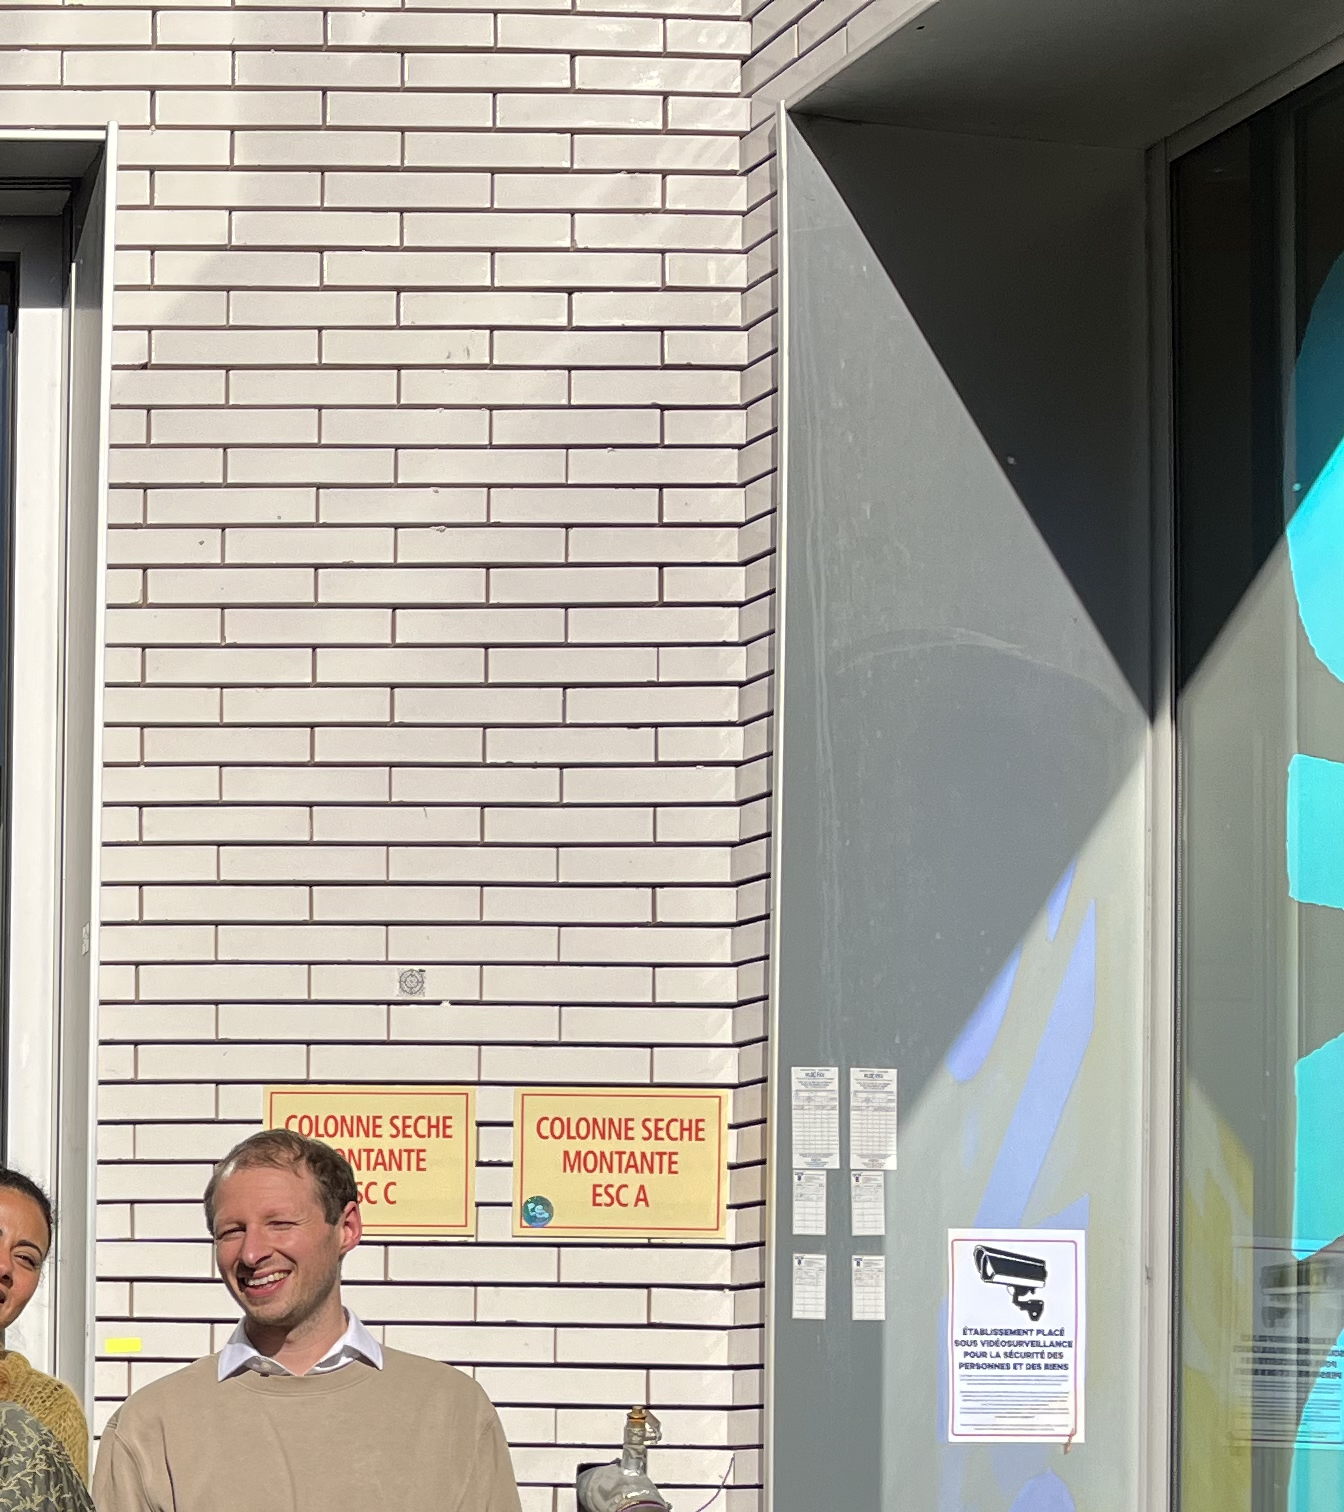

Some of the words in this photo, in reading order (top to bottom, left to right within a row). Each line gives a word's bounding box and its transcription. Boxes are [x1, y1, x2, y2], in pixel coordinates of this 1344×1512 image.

[284, 1114, 383, 1138] COLONNE
[389, 1115, 454, 1139] SECHE
[536, 1116, 635, 1141] COLONNE
[641, 1117, 706, 1142] SECHE
[562, 1150, 679, 1175] MONTANTE
[355, 1181, 378, 1205] SC
[383, 1181, 397, 1205] C
[592, 1183, 628, 1207] ESC
[633, 1184, 650, 1208] A
[954, 1339, 978, 1347] SOUS
[980, 1338, 1073, 1348] VIDÉOSURVEILLANCE
[962, 1325, 1034, 1337] ÉTABLISSEMENT
[1036, 1327, 1065, 1337] PLACÉ
[958, 1362, 1011, 1371] PERSONNES
[1013, 1362, 1024, 1371] ET
[1025, 1363, 1042, 1371] DES
[1044, 1363, 1069, 1371] BIENS
[963, 1351, 987, 1359] POUR
[989, 1351, 1001, 1359] LA
[1003, 1349, 1045, 1360] SÉCURITÉ
[1047, 1351, 1064, 1360] DES
